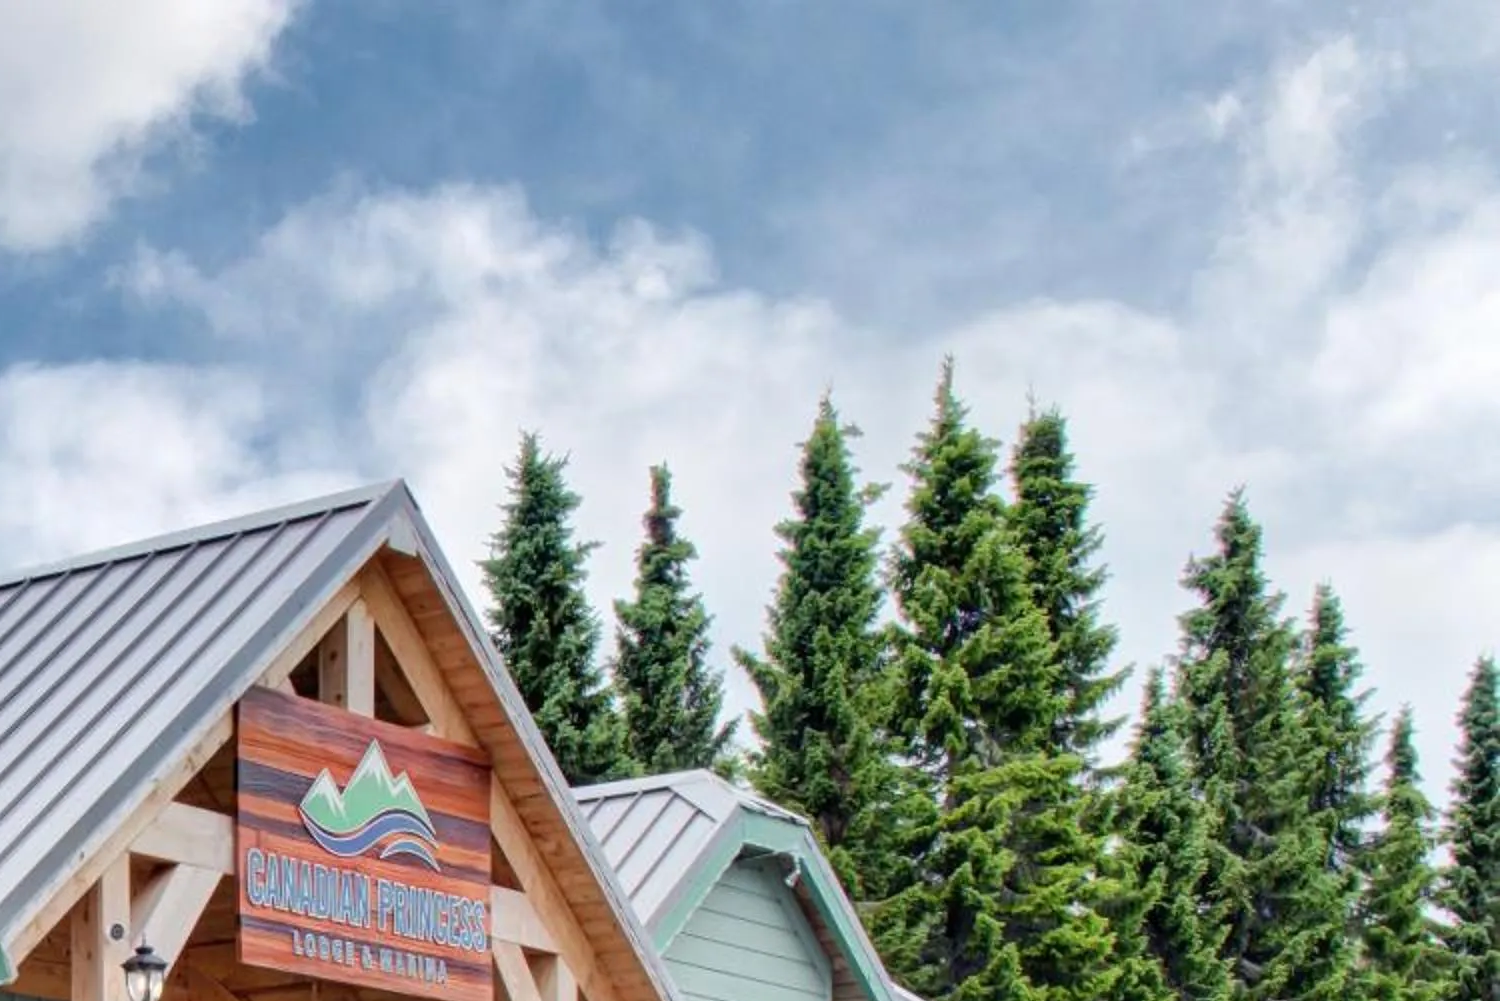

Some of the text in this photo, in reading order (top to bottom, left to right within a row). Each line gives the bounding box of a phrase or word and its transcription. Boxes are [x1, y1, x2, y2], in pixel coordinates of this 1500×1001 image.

[247, 848, 487, 953] CANADIAN PRINCESS
[293, 929, 356, 967] LODGE
